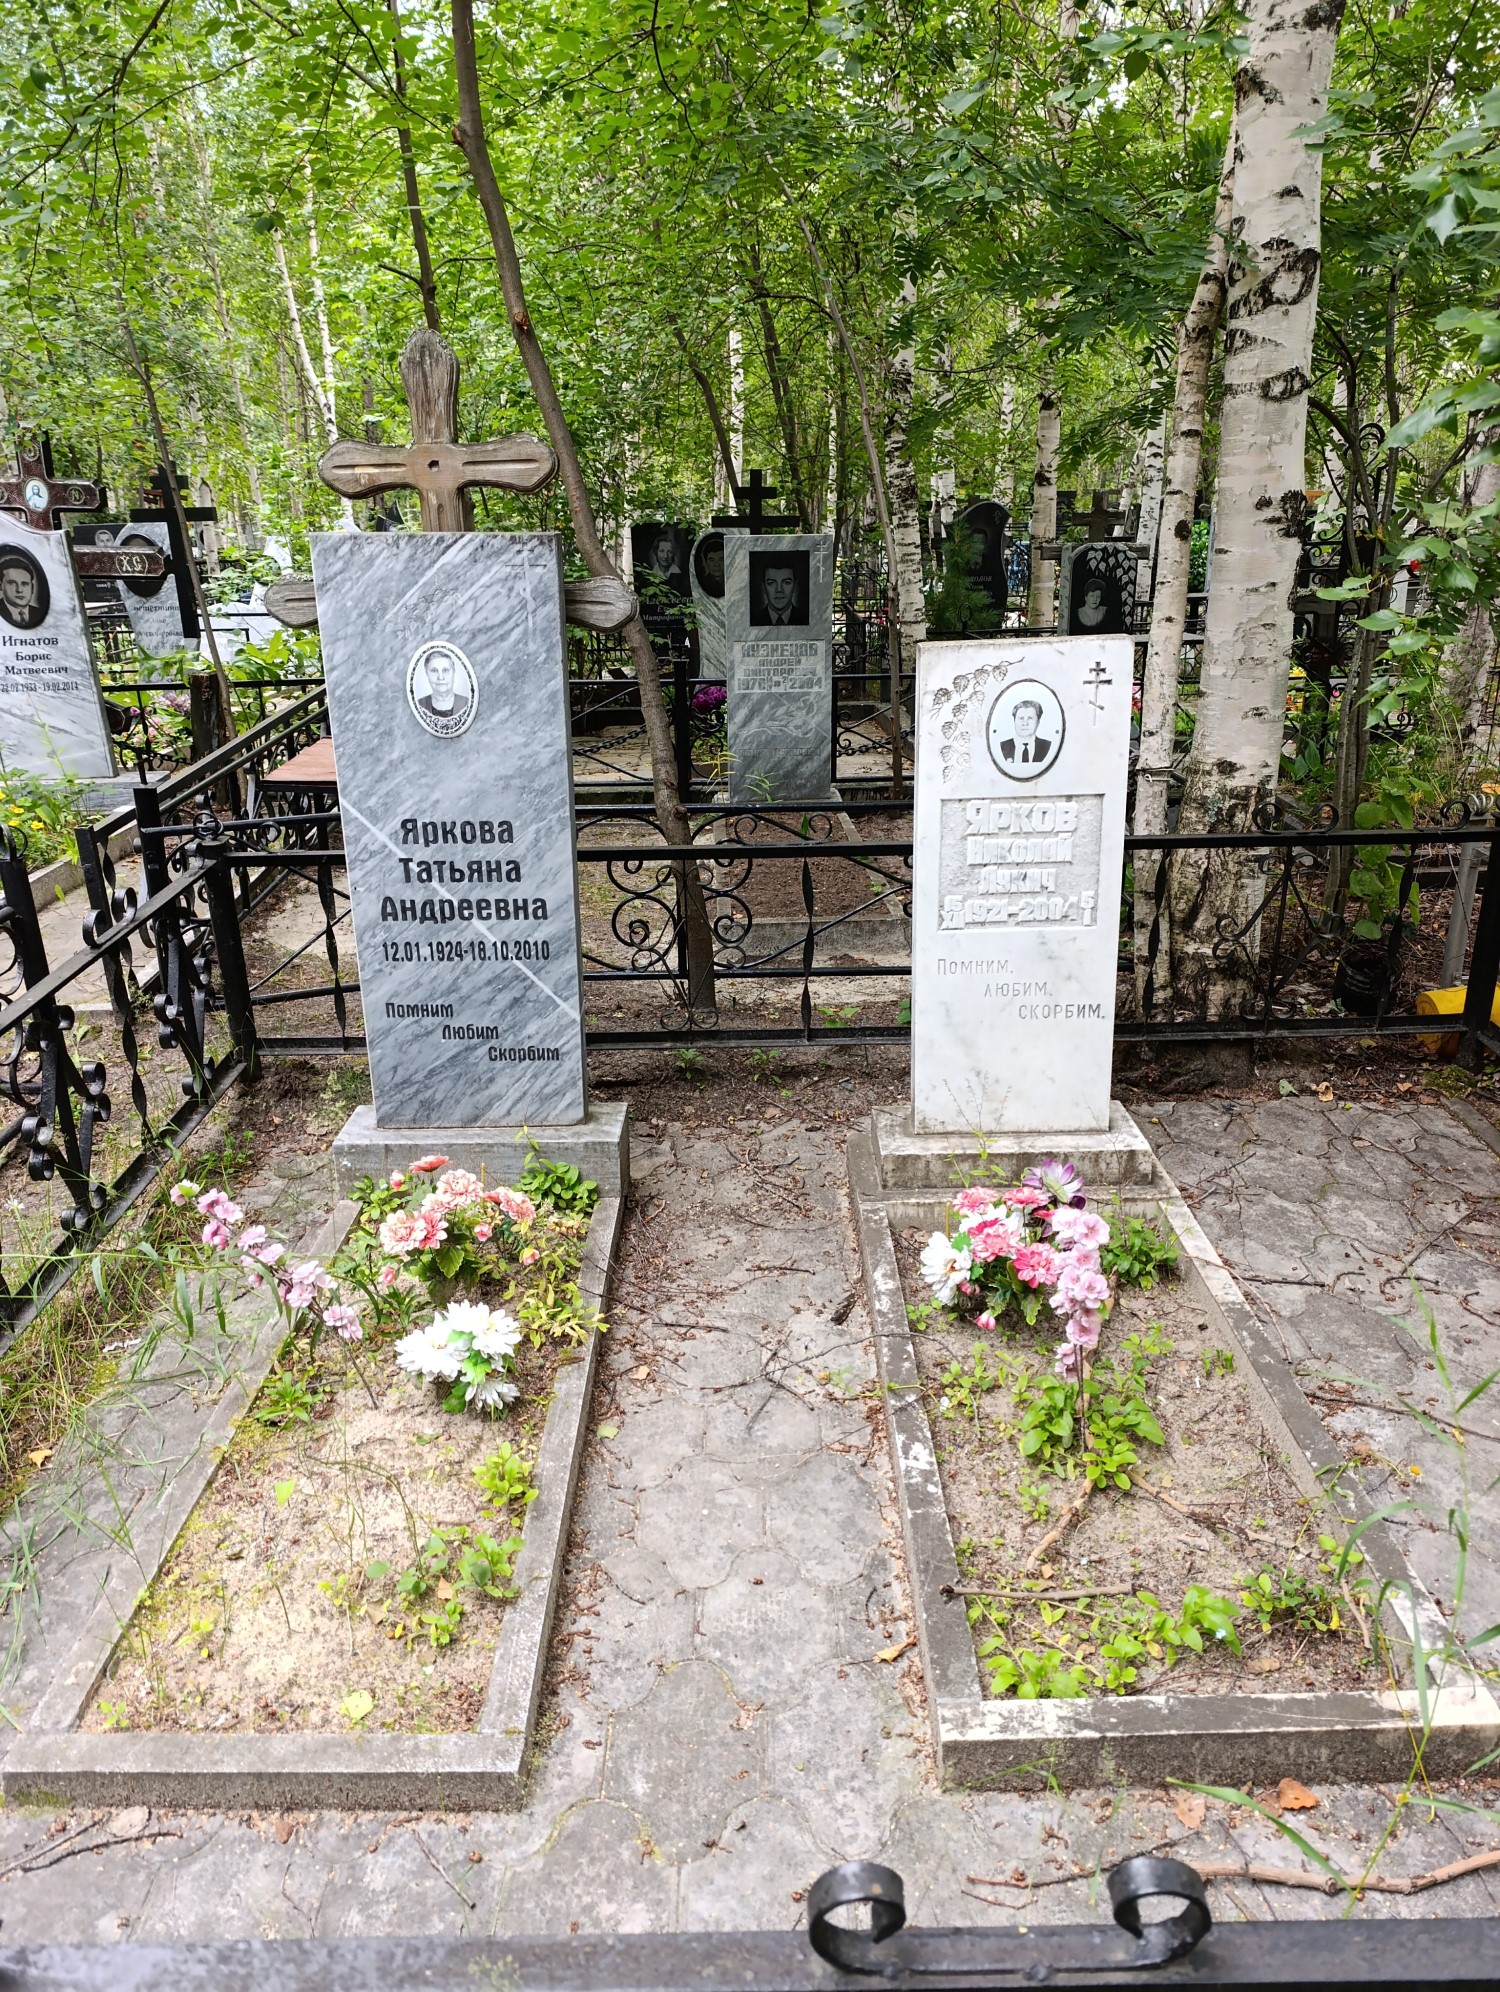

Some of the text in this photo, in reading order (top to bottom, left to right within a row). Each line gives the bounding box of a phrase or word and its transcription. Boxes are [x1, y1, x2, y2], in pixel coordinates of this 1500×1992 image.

[2, 635, 59, 647] Игнатов
[15, 651, 53, 663] Борис
[5, 665, 69, 675] Матвеевич
[965, 800, 1078, 835] ЯРКОВ
[400, 818, 514, 847] Яркова
[966, 833, 1073, 867] НИКОЛАЙ
[399, 857, 522, 883] Татьяна
[979, 866, 1058, 895] ЛУКИЧ
[380, 896, 548, 925] Андреевна
[382, 940, 550, 962] 12.01.1924-18.10.2010
[984, 982, 1053, 997] ЛЮБИМ.
[385, 1002, 454, 1018] Помним
[1018, 1003, 1106, 1020] СКОРБИМ.
[442, 1024, 499, 1040] Любим
[488, 1045, 560, 1063] Скорбим
